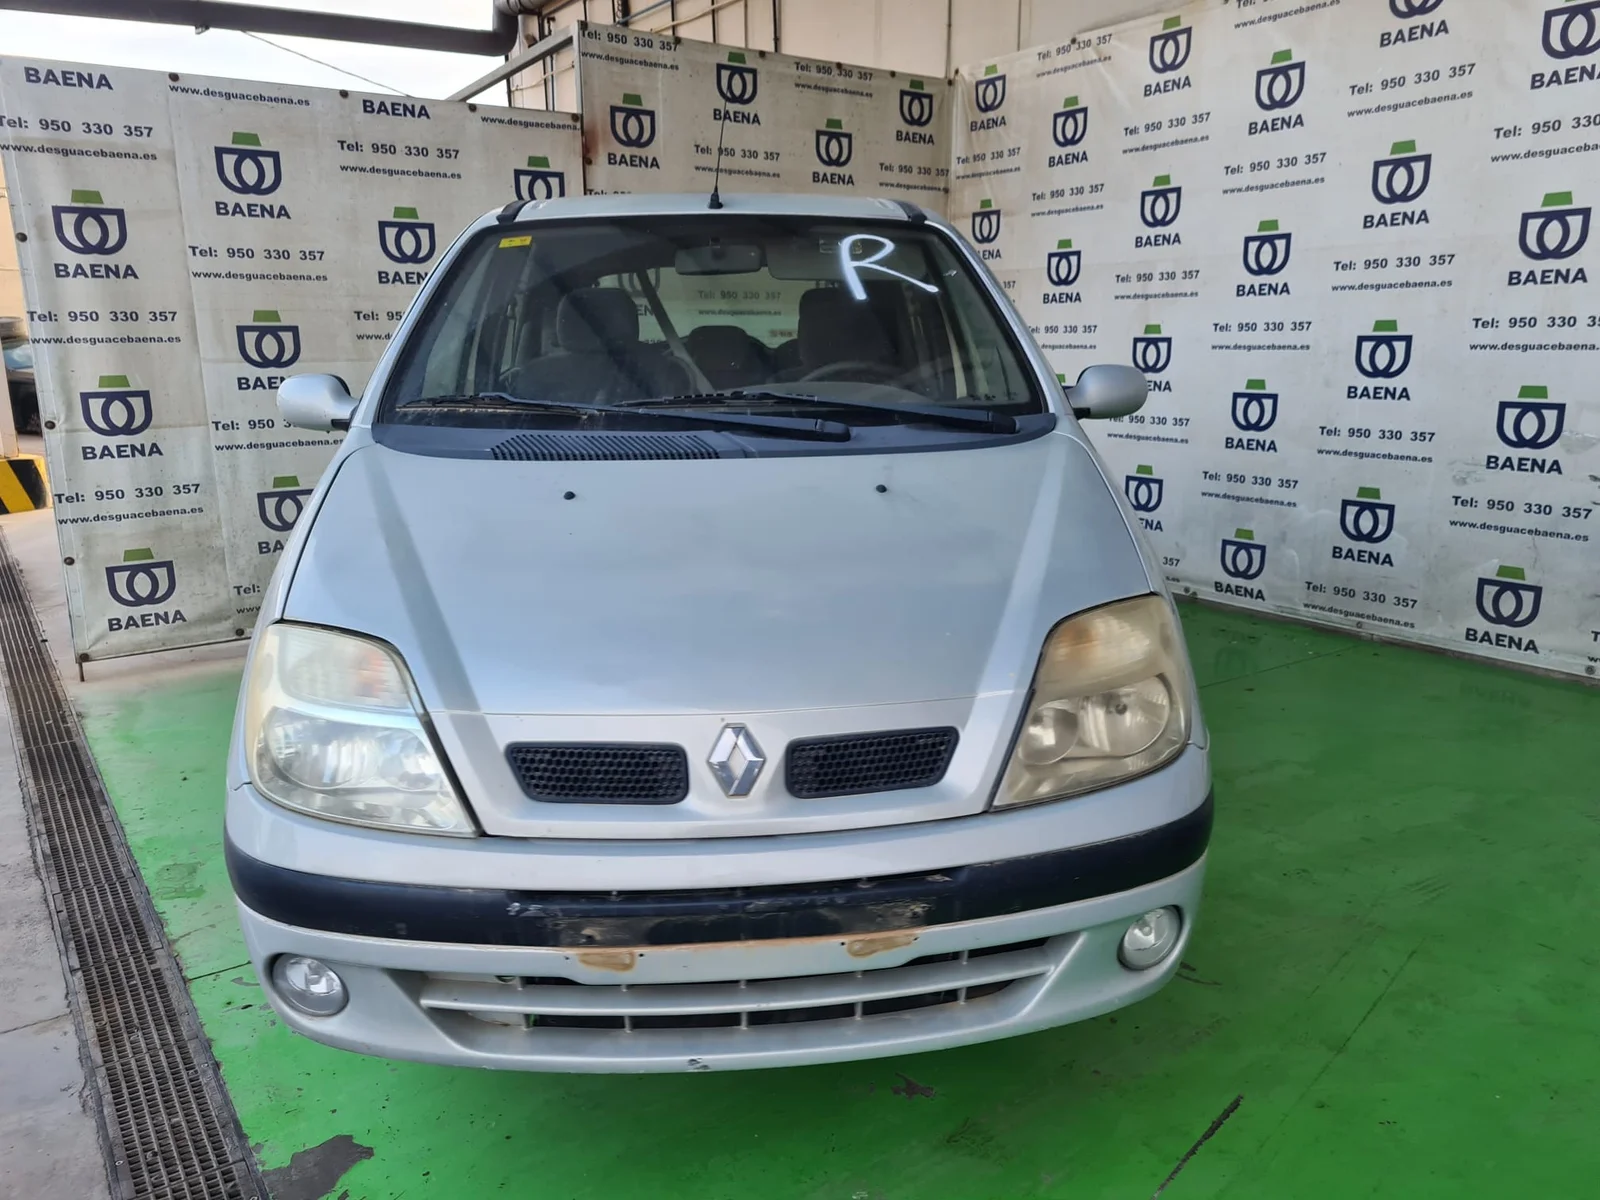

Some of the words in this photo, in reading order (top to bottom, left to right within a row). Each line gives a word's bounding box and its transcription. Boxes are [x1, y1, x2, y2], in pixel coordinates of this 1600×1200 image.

[607, 32, 628, 44] 950
[634, 36, 653, 48] 330
[659, 40, 678, 52] 357
[1380, 20, 1449, 48] BAENA
[1037, 50, 1052, 61] Tel:
[1056, 45, 1071, 56] 950
[1076, 36, 1092, 50] 330
[1096, 33, 1113, 46] 357
[24, 66, 114, 90] BAENA
[794, 61, 812, 72] Tel:
[816, 64, 833, 76] 950
[858, 70, 873, 81] 357
[1349, 82, 1373, 96] Tel:
[1381, 76, 1406, 90] 950
[1414, 69, 1440, 84] 330
[1448, 63, 1476, 78] 357
[1530, 64, 1600, 90] BAEN
[1144, 75, 1192, 97] BAENA
[168, 85, 310, 106] www.desguacebaena.es
[1347, 90, 1473, 118] www.desguacebaena.es
[362, 99, 430, 120] BAENA
[713, 108, 761, 126] BAENA
[0, 115, 28, 129] Tel:
[39, 118, 71, 132] 950
[82, 122, 113, 135] 330
[123, 125, 153, 138] 357
[970, 116, 1006, 132] BAENA
[1124, 126, 1140, 136] Tel:
[1144, 121, 1162, 133] 950
[1168, 116, 1186, 129] 330
[1192, 112, 1211, 124] 357
[1248, 114, 1304, 136] BAENA
[1494, 125, 1522, 139] Tel:
[1532, 119, 1562, 134] 950
[1571, 114, 1600, 129] 330
[896, 130, 935, 146] BAENA
[0, 144, 157, 160] www.desguacebaena.es
[337, 140, 364, 152] Tel:
[371, 143, 396, 155] 950
[404, 146, 429, 157] 330
[436, 148, 460, 159] 357
[694, 144, 712, 155] Tel:
[741, 149, 758, 159] 330
[764, 151, 780, 161] 357
[990, 150, 1004, 160] 330
[1007, 146, 1021, 158] 357
[608, 152, 660, 170] BAENA
[1048, 150, 1088, 168] BAENA
[1224, 164, 1244, 176] Tel:
[1250, 160, 1270, 172] 950
[1276, 156, 1298, 169] 330
[1304, 152, 1327, 165] 357
[340, 165, 462, 179] www.desguacebaena.es
[812, 171, 855, 186] BAENA
[879, 162, 894, 172] Tel:
[898, 164, 913, 174] 950
[917, 166, 932, 176] 330
[935, 168, 950, 178] 357
[1032, 192, 1046, 201] Tel:
[1050, 188, 1065, 199] 950
[1069, 186, 1084, 196] 330
[1089, 183, 1104, 194] 357
[215, 201, 292, 220] BAENA
[1363, 210, 1429, 229] BAENA
[1135, 233, 1181, 248] BAENA
[188, 245, 218, 258] Tel:
[226, 248, 254, 259] 950
[264, 249, 290, 260] 330
[299, 250, 324, 261] 357
[54, 263, 139, 280] BAENA
[1333, 260, 1356, 271] Tel:
[1364, 258, 1388, 270] 950
[1396, 256, 1421, 268] 330
[1429, 254, 1456, 266] 357
[192, 271, 328, 282] www.desguacebaena.es
[378, 271, 428, 285] BAEN
[1115, 274, 1132, 283] Tel:
[1136, 272, 1154, 282] 950
[1158, 271, 1176, 281] 330
[1182, 270, 1200, 280] 357
[1508, 268, 1588, 286] BAENA
[1236, 282, 1290, 297] BAENA
[1332, 280, 1452, 292] www.desguacebaena.es
[1043, 292, 1082, 304] BAENA
[26, 310, 58, 322] Tel:
[68, 311, 99, 322] 950
[109, 311, 139, 322] 330
[148, 311, 177, 322] 357
[354, 310, 379, 321] Tel:
[1472, 318, 1499, 329] Tel:
[1508, 316, 1537, 328] 950
[1547, 316, 1577, 328] 330
[1044, 325, 1059, 334] 950
[1063, 325, 1078, 334] 330
[1082, 324, 1098, 334] 357
[1213, 323, 1232, 332] Tel:
[1237, 322, 1258, 332] 950
[1264, 322, 1284, 332] 330
[1290, 321, 1312, 332] 357
[30, 335, 181, 346] www.desguacebaena.es
[1469, 342, 1600, 352] www.desguacebaena.
[1347, 386, 1410, 401] BAENA
[211, 420, 240, 431] Tel:
[248, 418, 275, 430] 950
[1128, 415, 1145, 424] 950
[1150, 416, 1167, 426] 330
[1172, 417, 1190, 427] 357
[1319, 426, 1341, 436] Tel:
[1348, 428, 1371, 438] 950
[1378, 429, 1402, 440] 330
[1410, 431, 1436, 442] 357
[81, 442, 164, 460] BAENA
[1225, 437, 1277, 453] BAENA
[1317, 449, 1433, 463] www.desguacebaena.es
[1486, 455, 1562, 475] BAENA
[1202, 471, 1221, 481] Tel:
[1226, 473, 1246, 484] 950
[1251, 476, 1272, 487] 330
[1278, 478, 1298, 489] 357
[54, 492, 85, 504] Tel:
[94, 489, 125, 501] 950
[135, 486, 163, 498] 330
[172, 483, 200, 495] 357
[58, 507, 204, 525] www.desguacebaena.es
[1452, 495, 1478, 508] Tel:
[1487, 499, 1514, 512] 950
[1524, 502, 1552, 516] 330
[1562, 506, 1592, 520] 357
[1449, 520, 1589, 542] www.desguacebaena.es
[1162, 556, 1180, 567] 357
[1332, 546, 1394, 567] BAENA
[233, 584, 261, 596] Tel:
[1214, 581, 1266, 602] BAENA
[1305, 581, 1326, 593] Tel:
[1333, 586, 1356, 598] 950
[1362, 590, 1386, 604] 330
[1393, 596, 1418, 609] 357
[108, 610, 187, 632] BAENA
[1303, 602, 1415, 629] www.desguacebaena.es
[1465, 627, 1539, 654] BAENA
